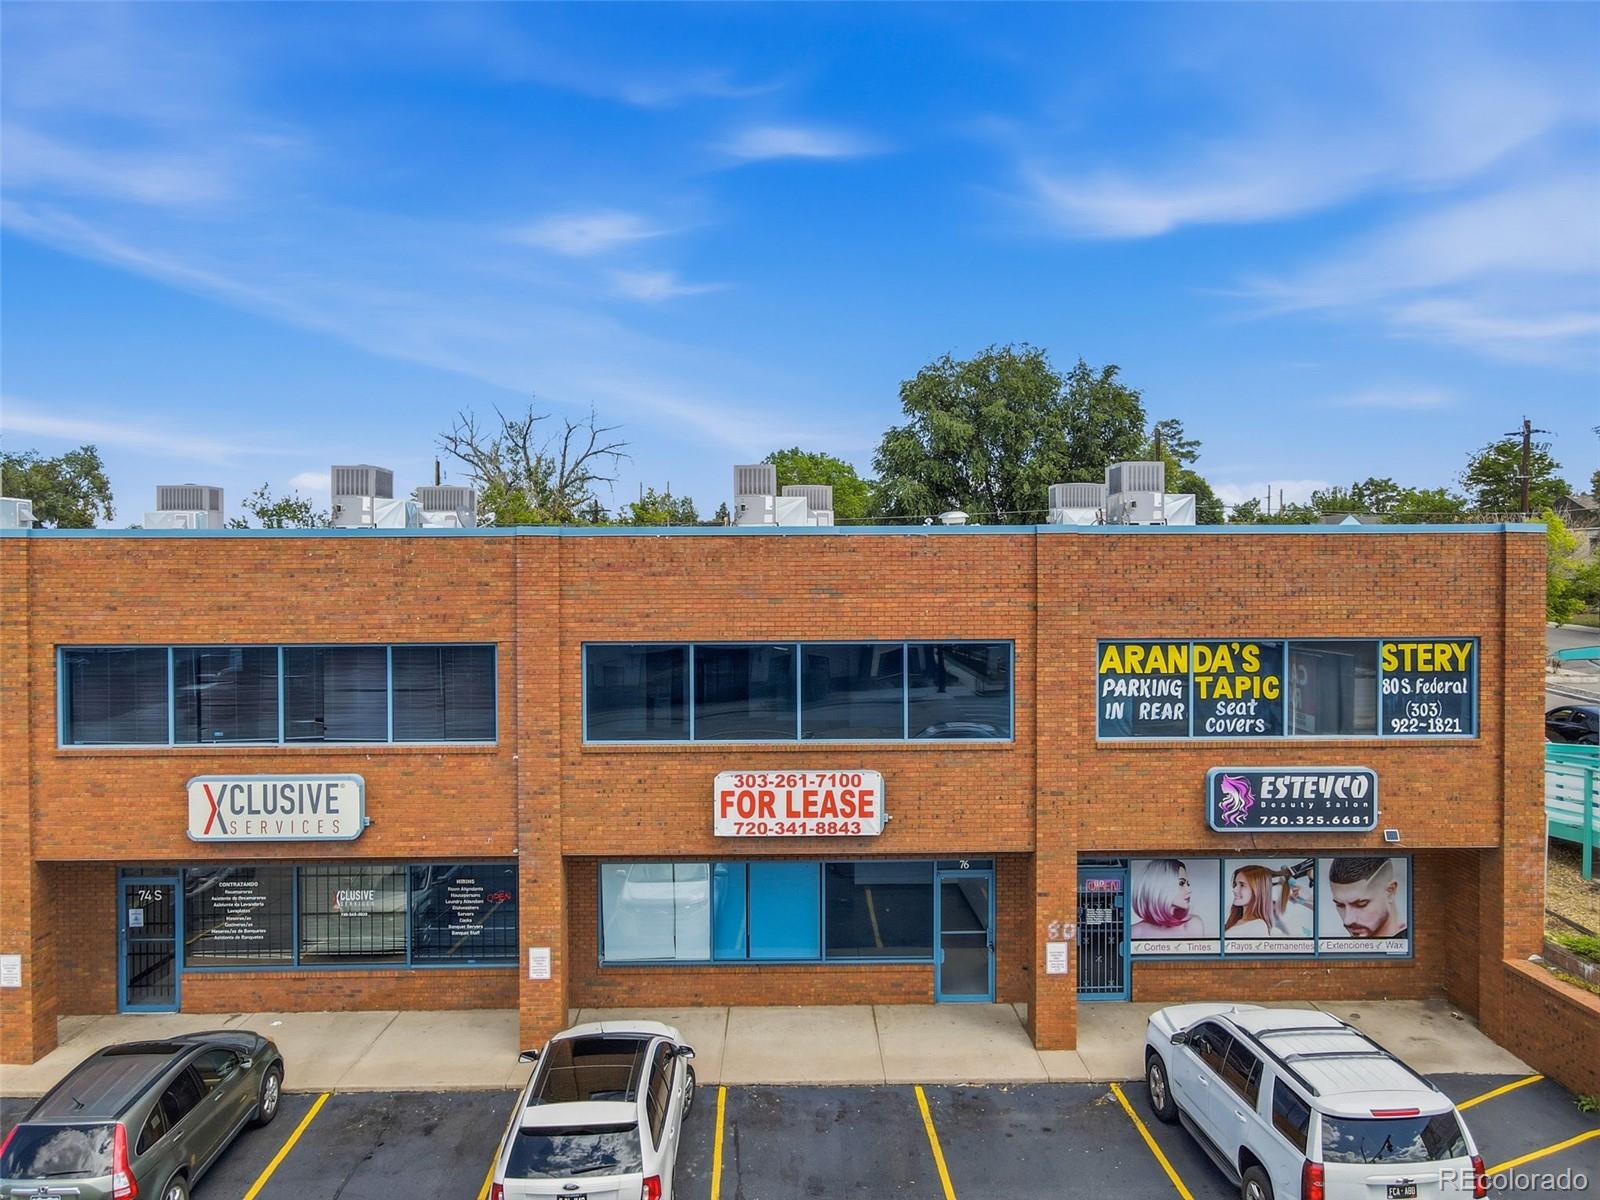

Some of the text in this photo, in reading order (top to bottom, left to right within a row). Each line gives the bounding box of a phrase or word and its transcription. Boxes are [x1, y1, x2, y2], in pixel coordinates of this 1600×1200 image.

[1099, 642, 1261, 673] ARANDA'S
[1381, 642, 1473, 672] STERY
[1102, 678, 1183, 699] PARKING
[1194, 676, 1280, 699] TAPIC
[1382, 678, 1400, 694] 80
[1415, 676, 1467, 694] Federal
[1104, 702, 1186, 720] IN REAR
[1405, 700, 1443, 718] (303)
[733, 773, 862, 788] 303-261-7100
[1260, 775, 1369, 799] ESTEYCO
[203, 783, 340, 835] XCLUSIVE
[720, 789, 875, 818] FOR LEASE
[1260, 801, 1369, 810] Beauty Salon
[230, 819, 341, 834] SERVICES
[733, 821, 862, 835] 720-341-8843
[1259, 815, 1370, 825] 720.325.6681
[959, 859, 970, 870] 76
[138, 890, 162, 901] 74 S
[1143, 942, 1212, 951] Cortes Tintes
[1230, 941, 1315, 952] Rayos Permanentes
[1326, 941, 1404, 950] Extenciones Wax
